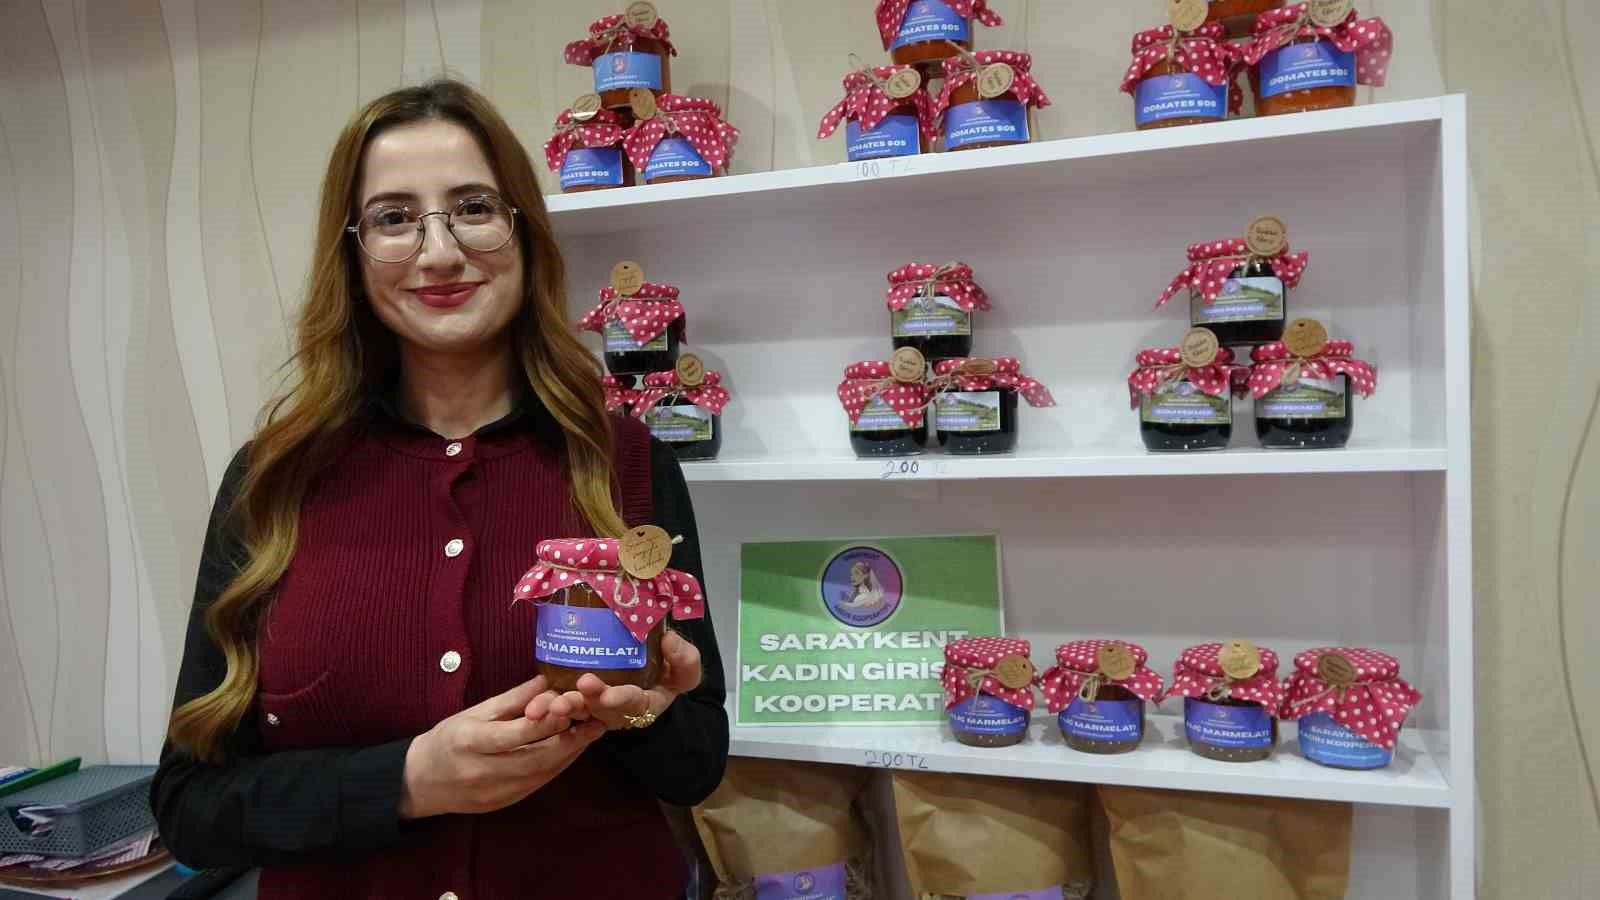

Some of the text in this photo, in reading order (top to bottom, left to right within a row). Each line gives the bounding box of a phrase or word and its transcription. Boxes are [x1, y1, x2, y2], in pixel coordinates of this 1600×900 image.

[881, 460, 920, 480] 200
[549, 643, 639, 656] MARMELATI
[760, 631, 968, 652] SARAYKENT
[743, 664, 856, 682] KADIN
